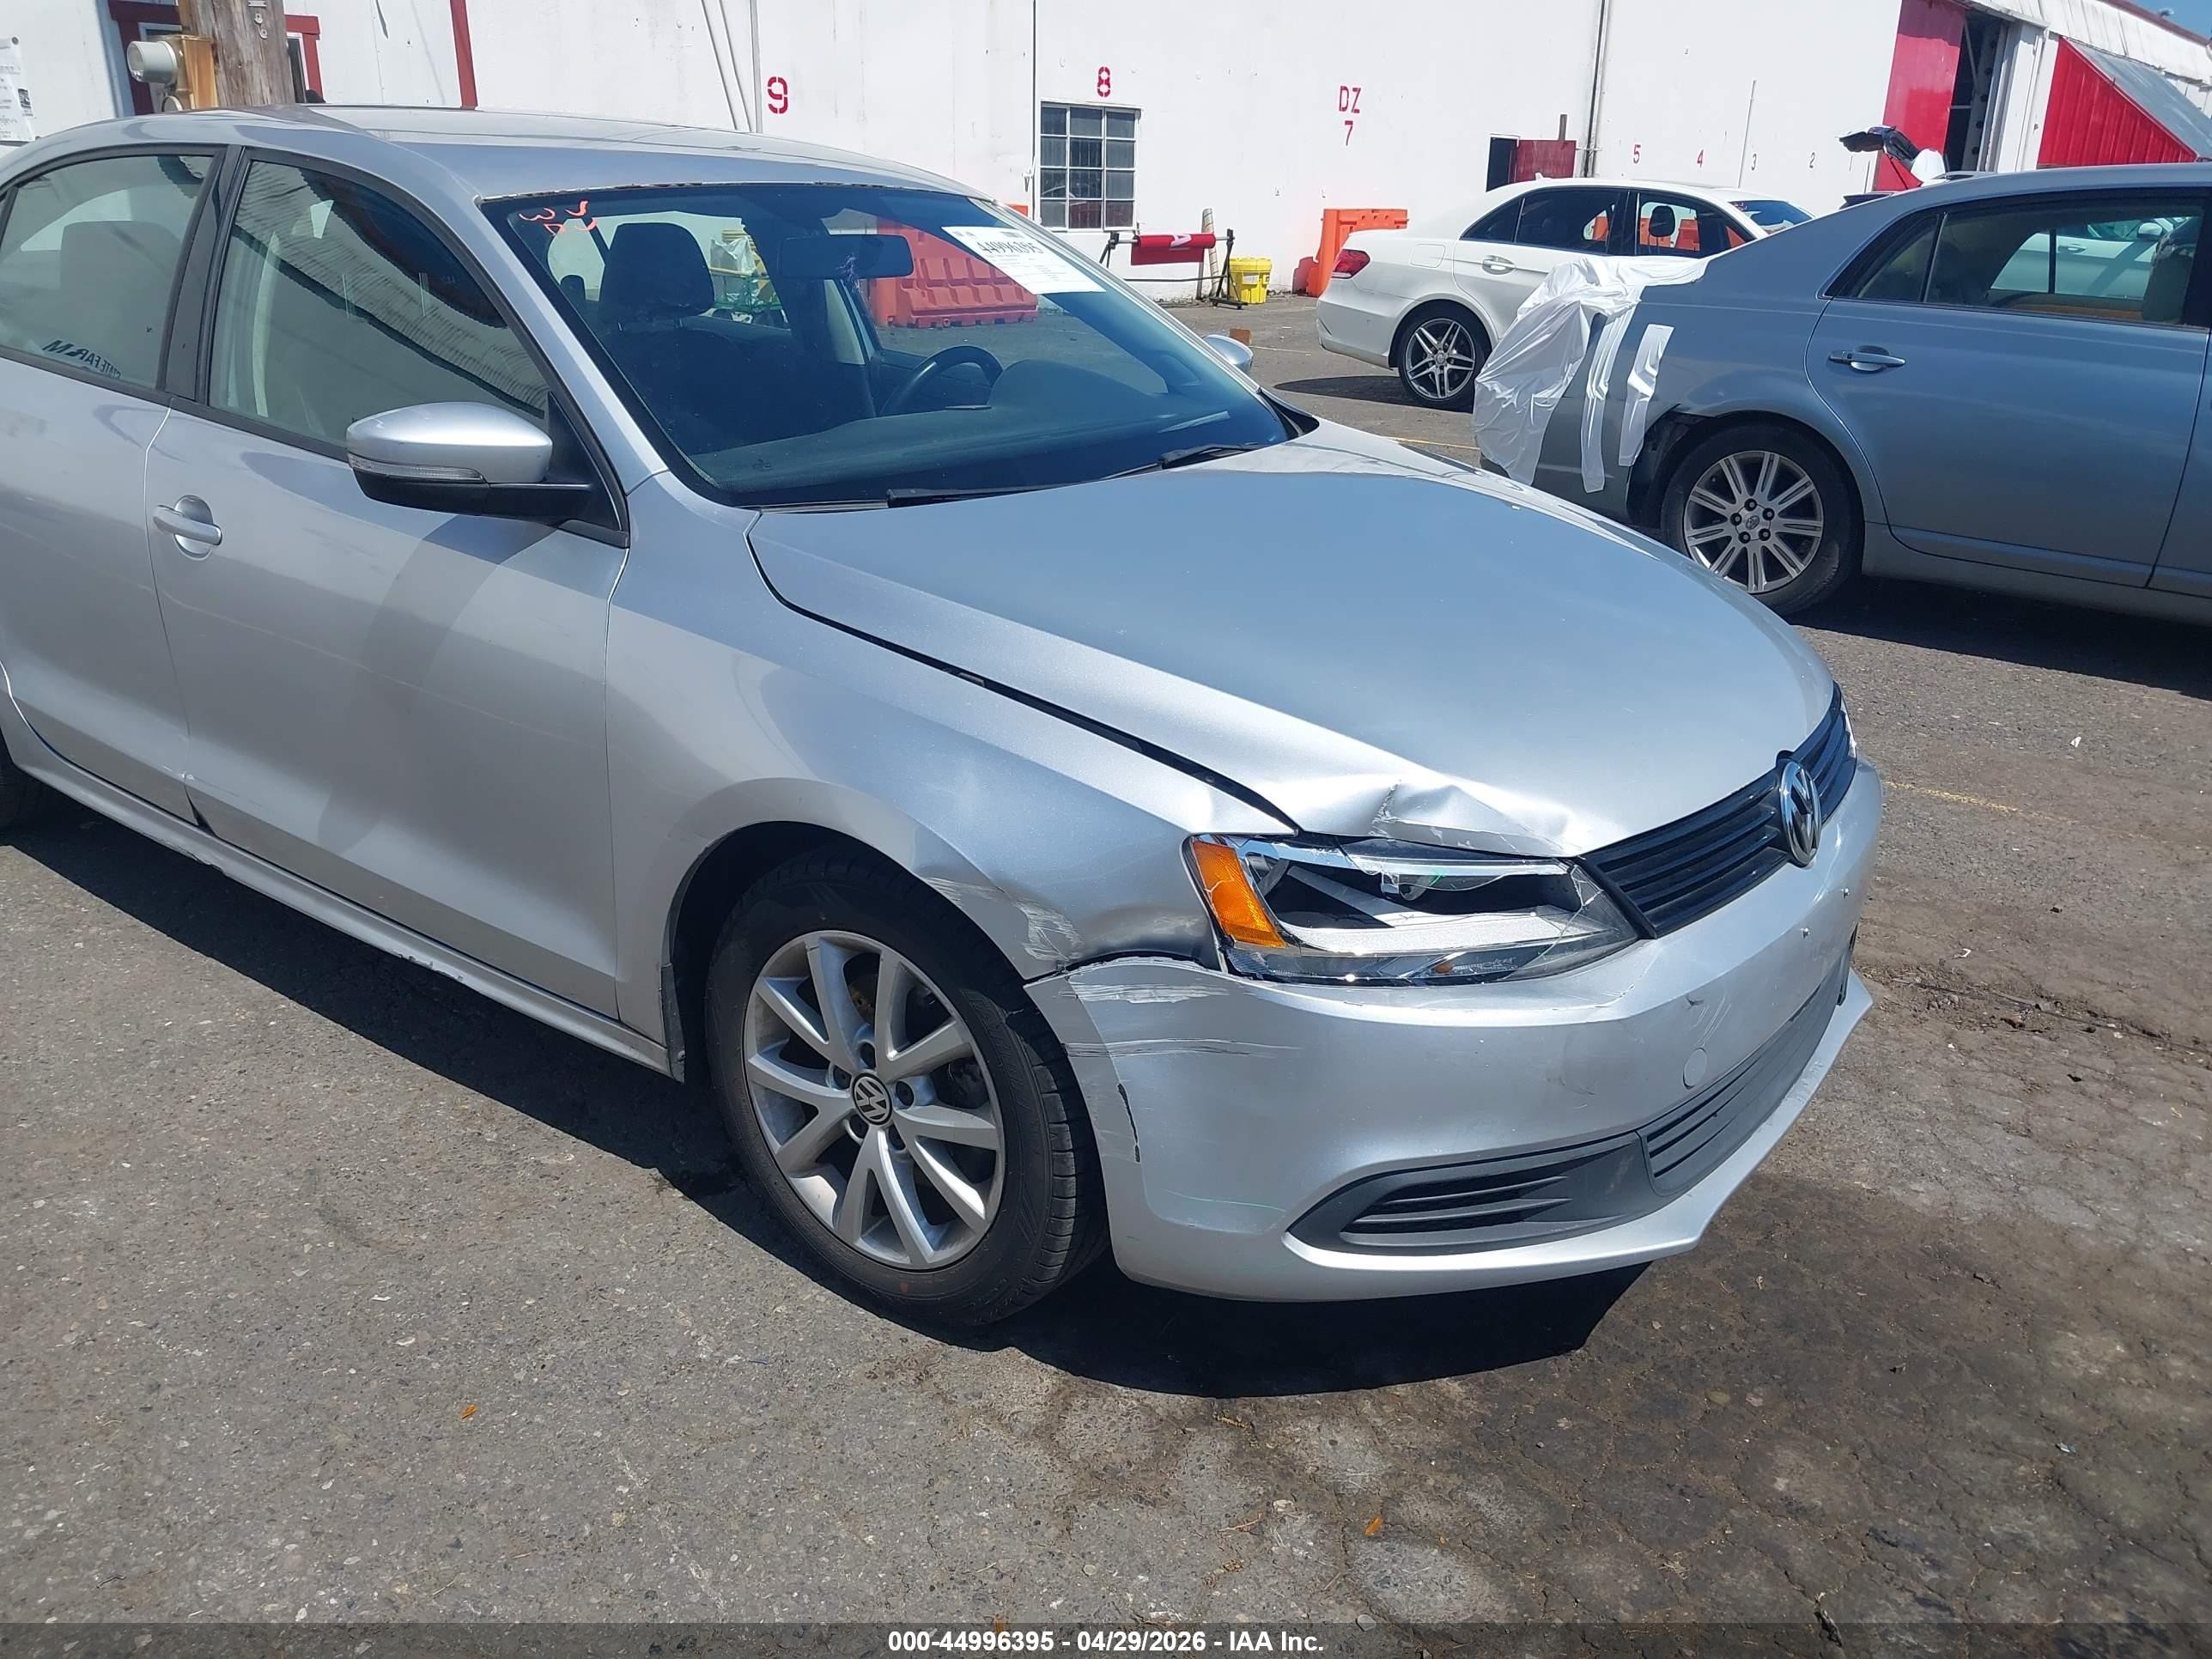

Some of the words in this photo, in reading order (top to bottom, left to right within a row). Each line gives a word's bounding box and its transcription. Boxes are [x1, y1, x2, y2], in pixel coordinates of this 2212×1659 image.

[1097, 66, 1110, 98] 8
[767, 76, 788, 114] 9
[1339, 85, 1362, 114] DZ
[1344, 119, 1353, 146] 7
[1632, 143, 1641, 164] 5
[1696, 149, 1705, 168] 4
[1751, 153, 1757, 171] 3
[1808, 151, 1815, 169] 2
